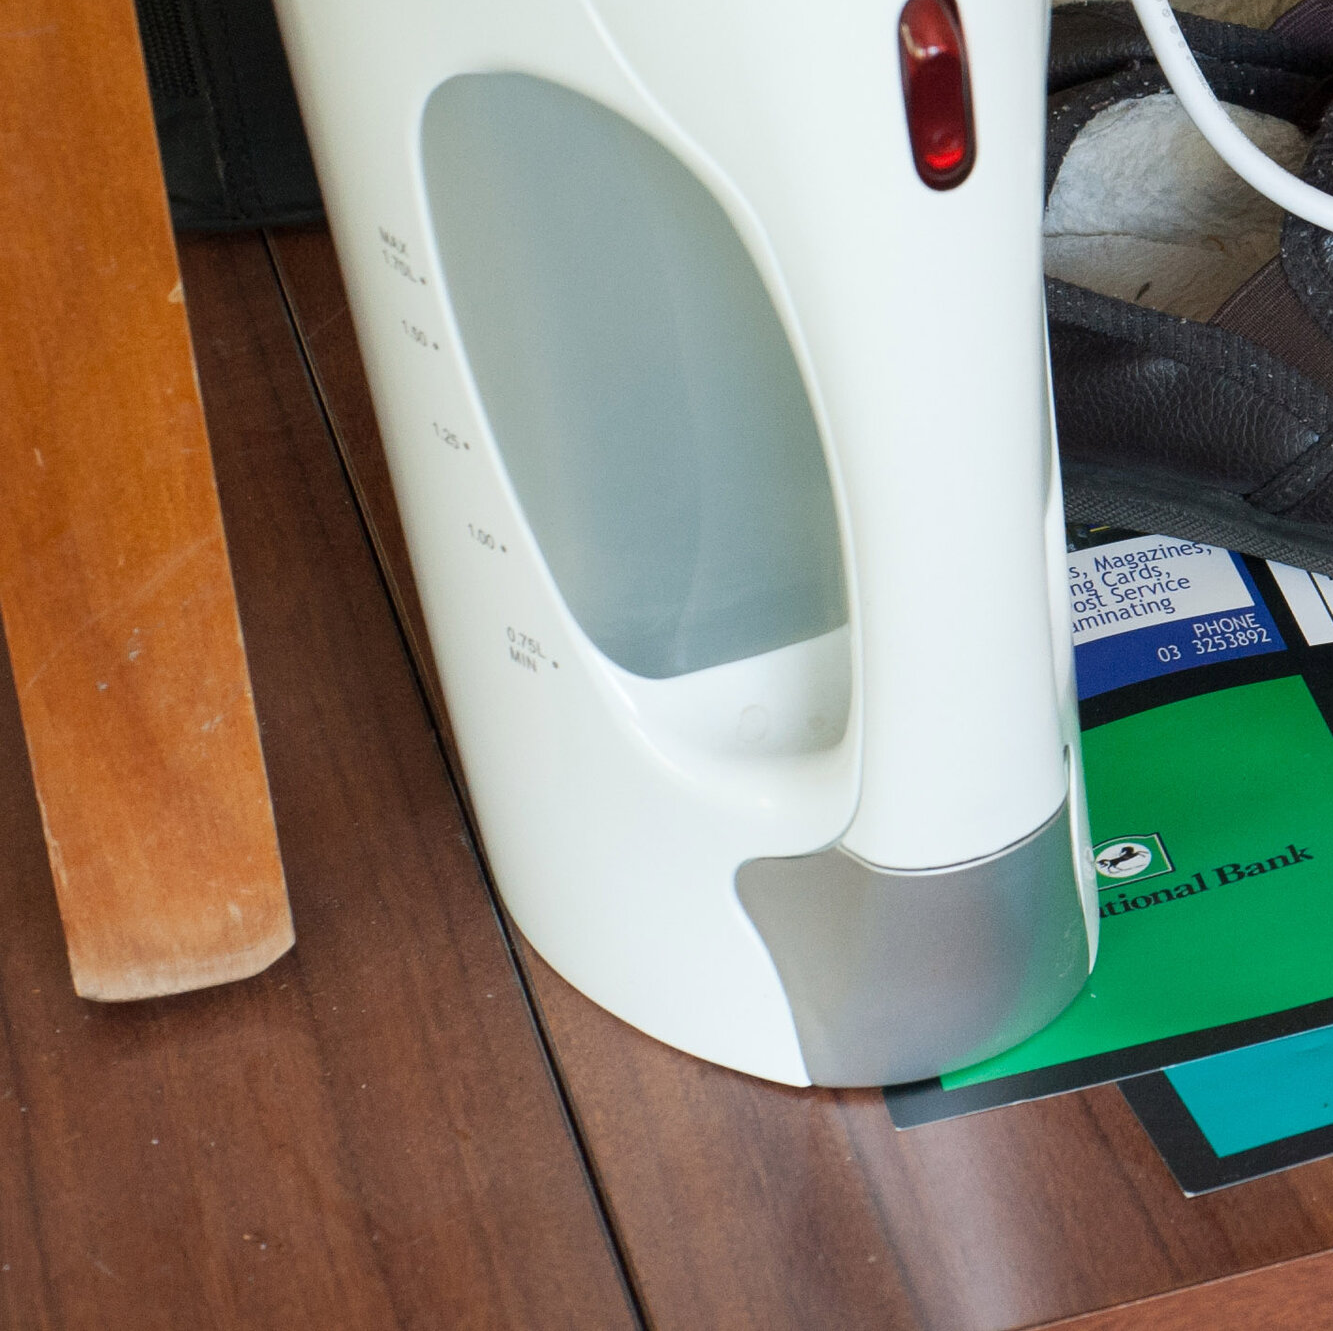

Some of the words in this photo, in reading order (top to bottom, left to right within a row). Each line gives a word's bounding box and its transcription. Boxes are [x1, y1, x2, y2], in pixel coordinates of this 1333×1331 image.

[432, 422, 461, 450] 1.25
[467, 523, 495, 550] 1.00
[1093, 541, 1213, 572] Magazines,
[1101, 563, 1171, 588] Cards,
[1074, 592, 1107, 614] ost
[1110, 576, 1191, 604] Service
[1072, 596, 1176, 634] aminating
[1192, 613, 1260, 638] PHONE
[506, 626, 546, 659] 0.75L
[1157, 644, 1182, 663] 03
[1191, 627, 1272, 655] 3253892
[509, 646, 537, 673] MIN
[1099, 872, 1211, 919] tional
[1211, 844, 1314, 887] Bank
